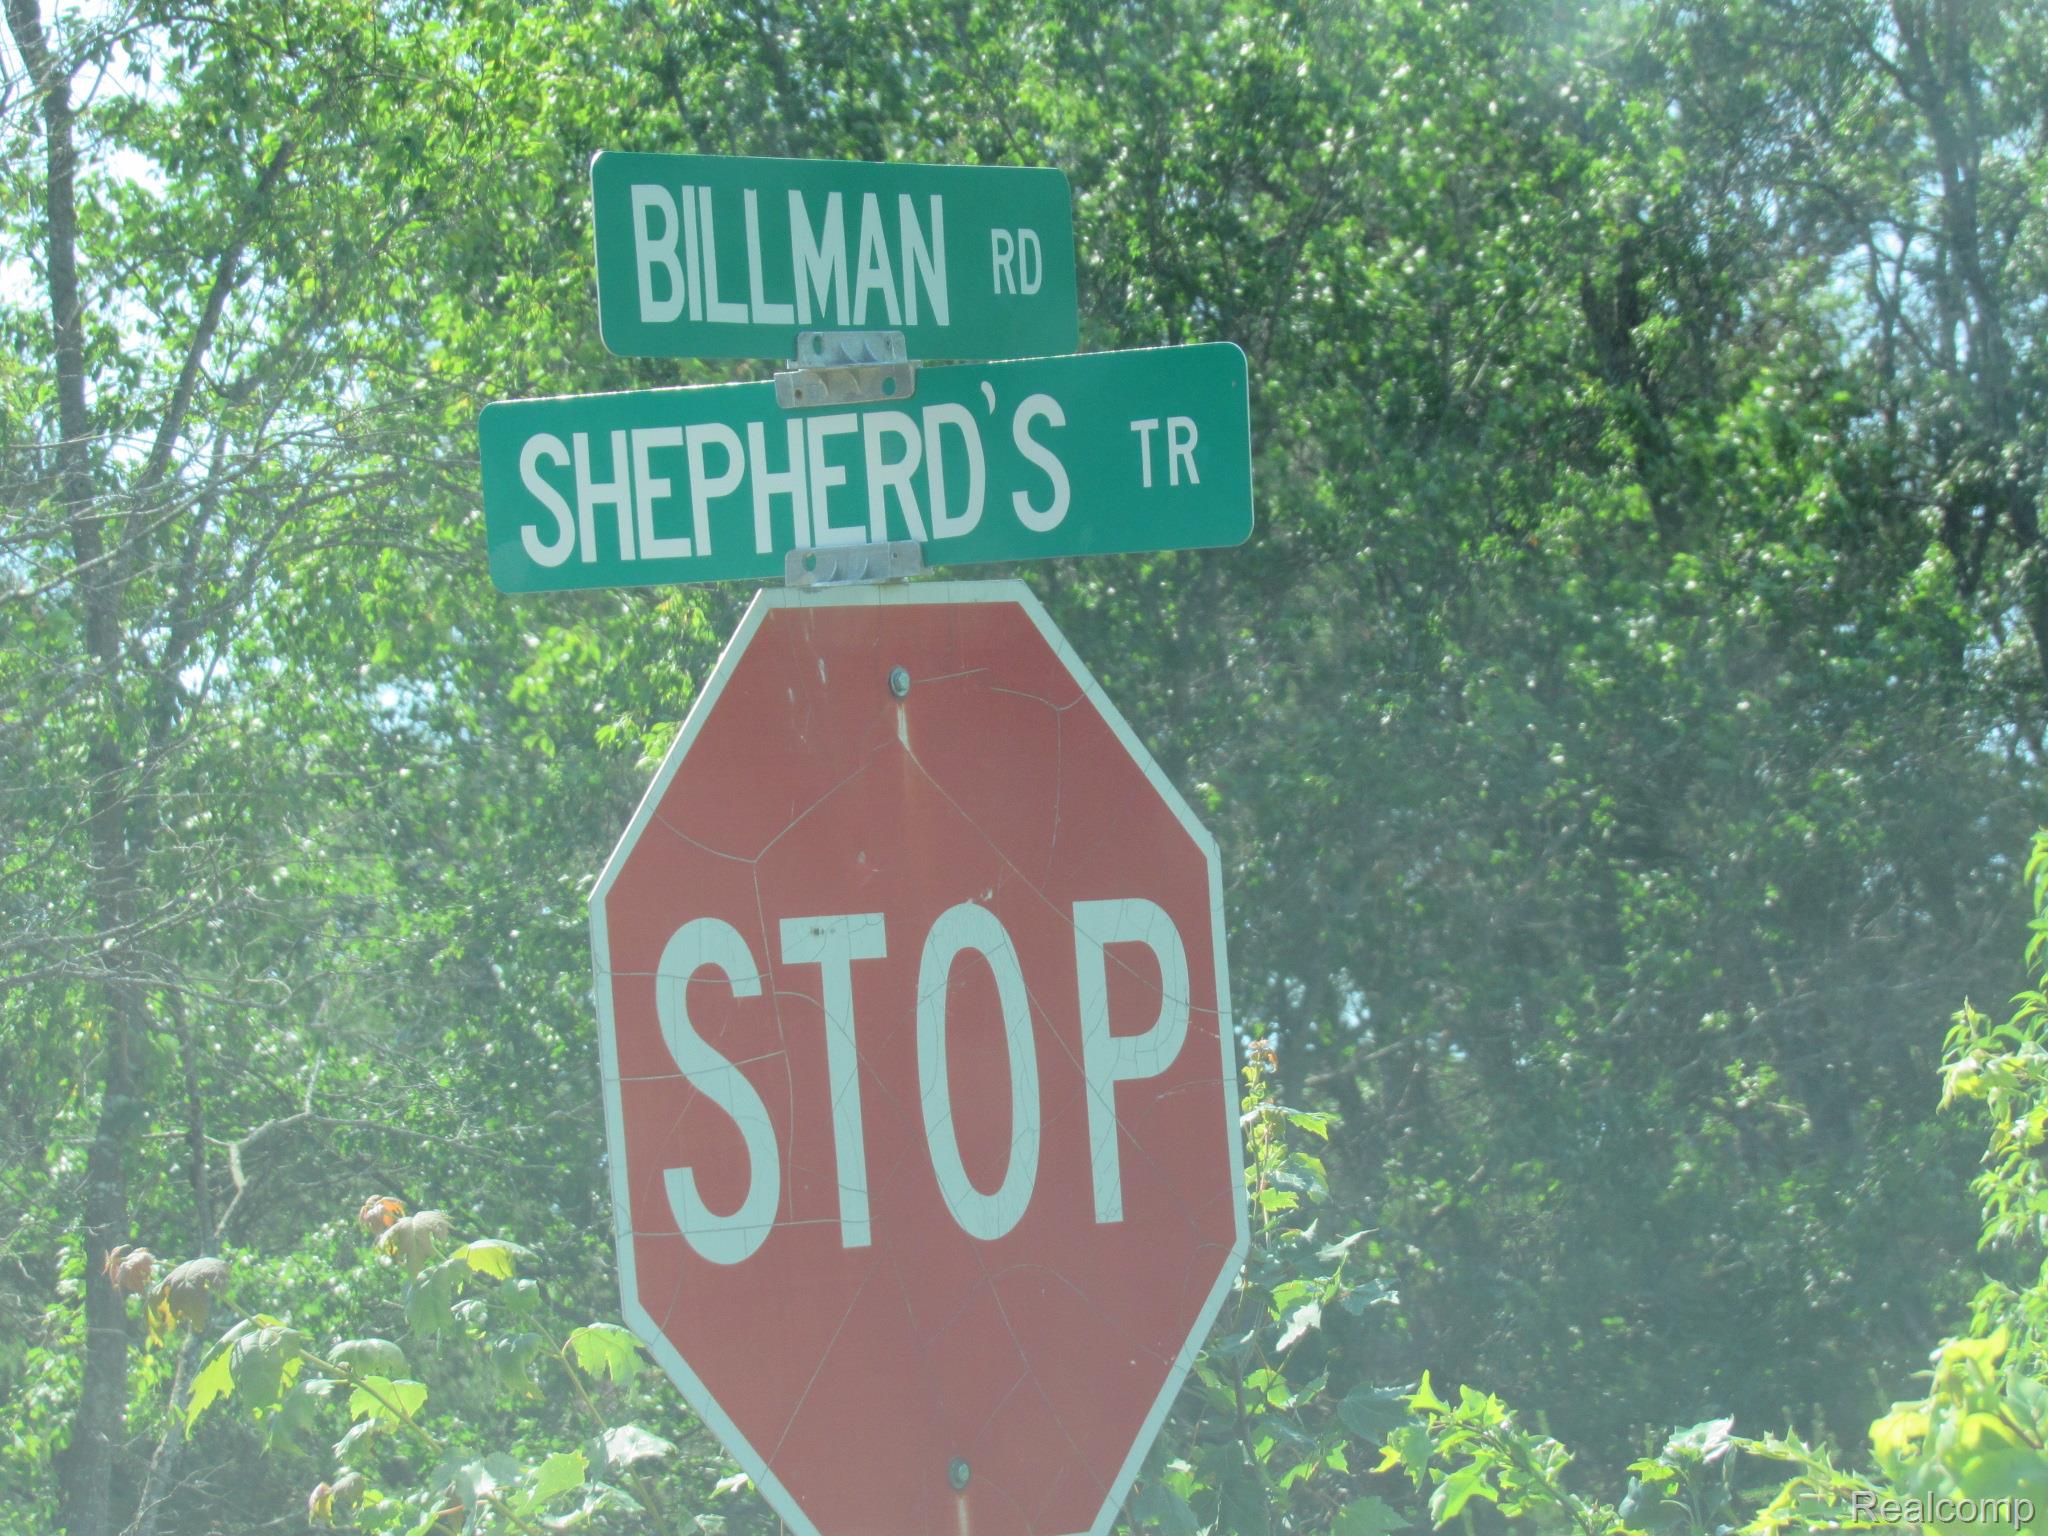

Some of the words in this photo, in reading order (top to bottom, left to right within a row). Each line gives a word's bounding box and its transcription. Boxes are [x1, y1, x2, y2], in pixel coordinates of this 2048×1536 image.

[631, 184, 949, 326] BILLMAN
[992, 229, 1042, 295] RD
[519, 381, 1071, 568] SHEPHERD'S
[1130, 416, 1200, 488] TR
[655, 897, 1191, 1265] STOP
